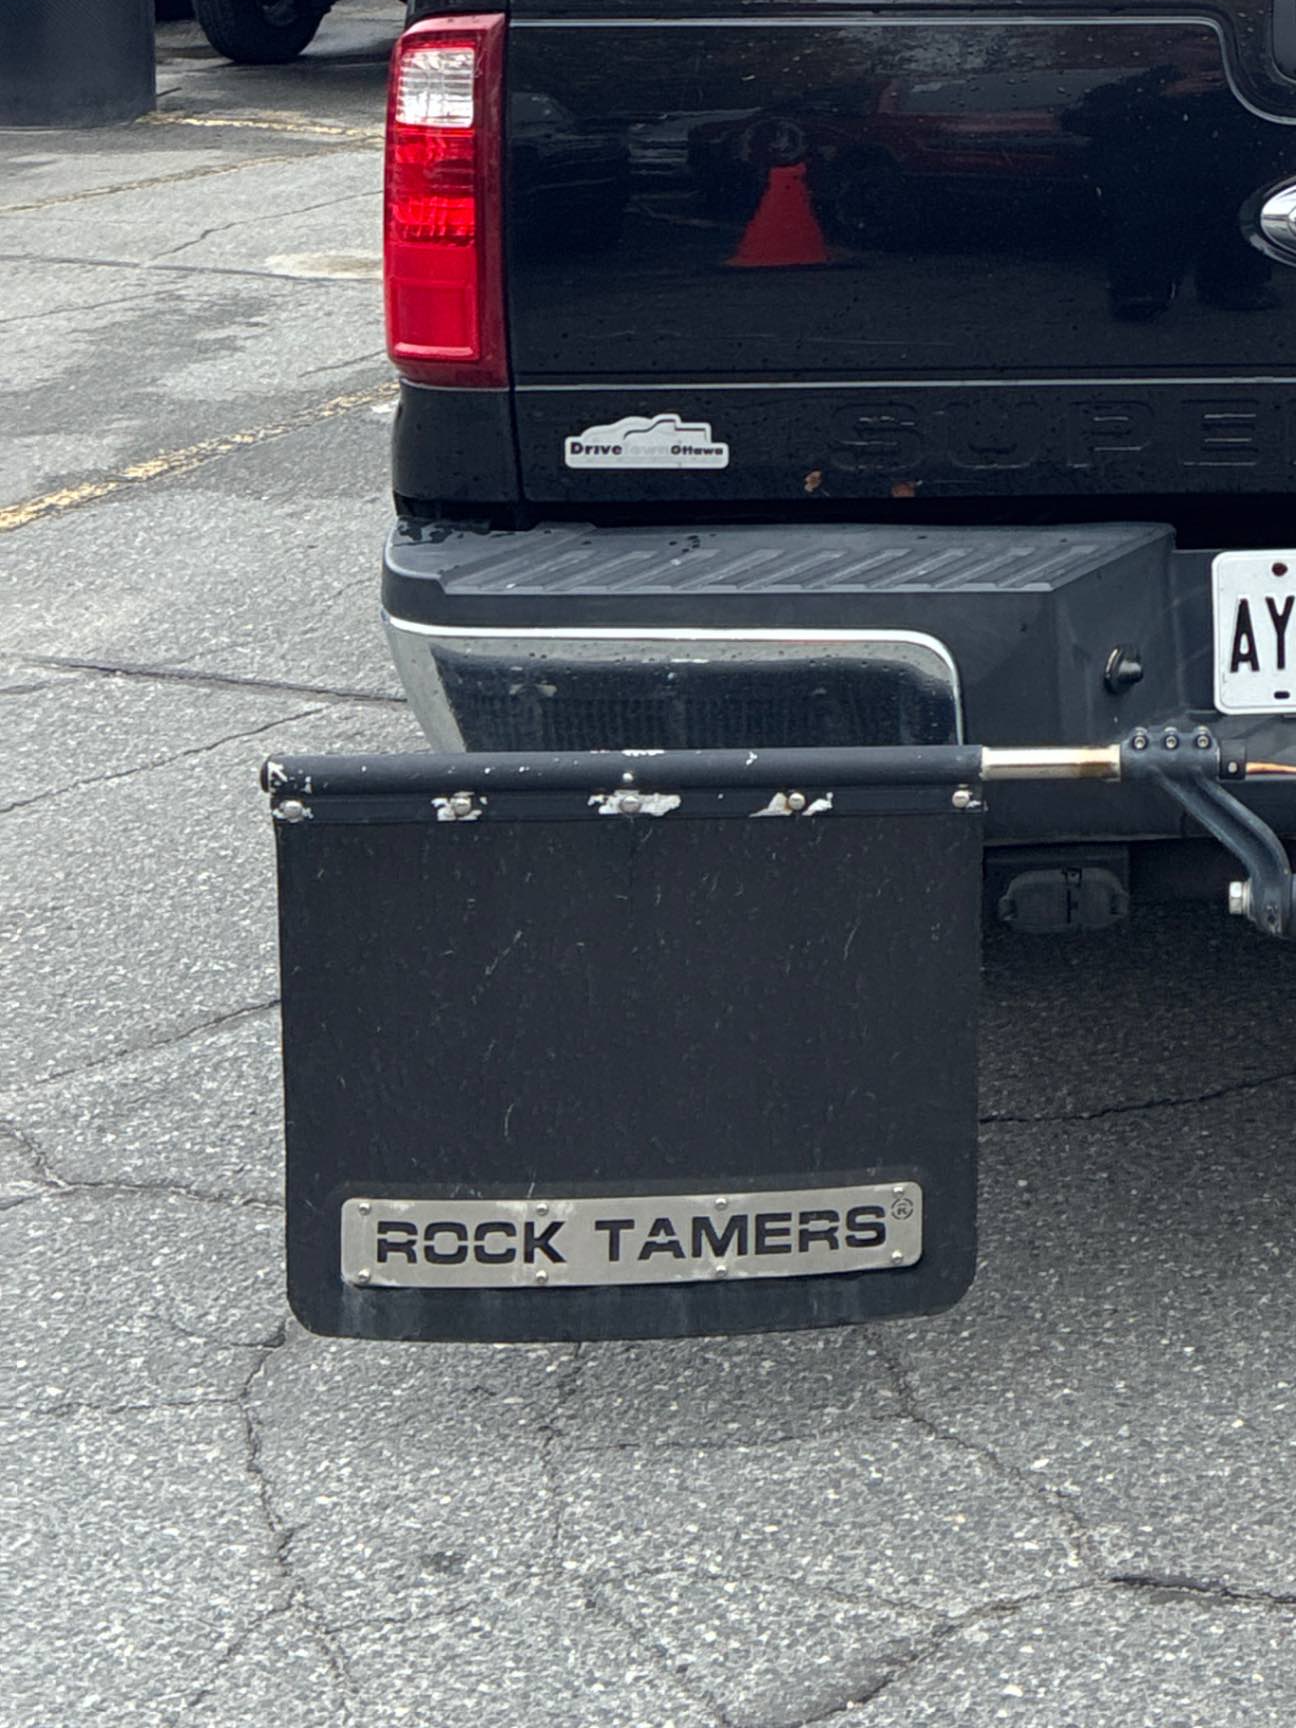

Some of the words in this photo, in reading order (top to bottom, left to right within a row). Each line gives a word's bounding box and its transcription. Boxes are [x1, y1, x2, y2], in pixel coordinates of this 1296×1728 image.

[570, 442, 623, 455] Drive
[671, 445, 724, 455] Ottawa
[376, 1219, 567, 1265] ROCK
